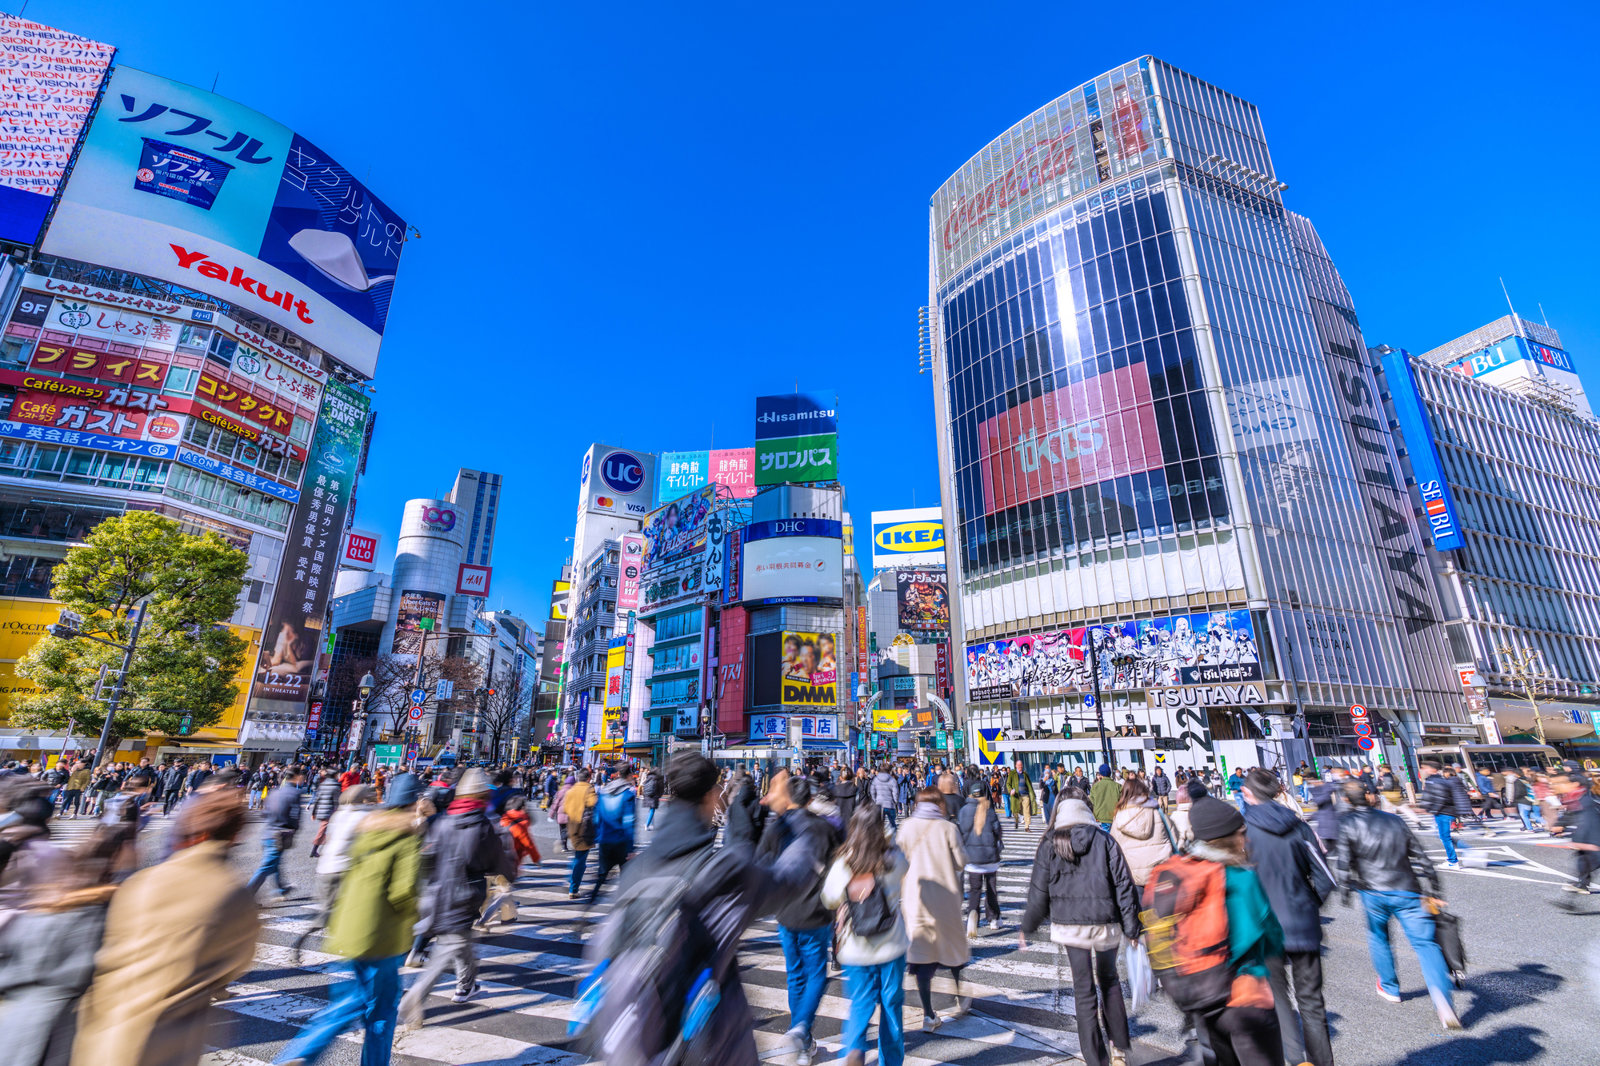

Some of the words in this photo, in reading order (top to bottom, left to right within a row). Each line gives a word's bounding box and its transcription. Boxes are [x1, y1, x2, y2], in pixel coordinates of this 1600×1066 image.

[118, 94, 273, 165] ソフール
[152, 154, 215, 183] ソフール
[290, 146, 404, 245] ヤクルトの
[1092, 180, 1145, 208] QFRONT
[282, 162, 399, 260] ヨーグルト
[45, 278, 181, 315] しゃぶしゃぶバイキング
[168, 243, 314, 325] Yakult
[20, 301, 48, 317] 9F
[96, 311, 173, 341] しゃぶ葉
[235, 323, 324, 378] しゃぶしゃぶバイキング
[37, 346, 161, 383] プライス
[264, 362, 319, 401] しゃぶ葉
[20, 400, 57, 416] Café
[105, 387, 169, 411] ガスト
[197, 375, 289, 428] コンタクト
[325, 393, 366, 422] PERFECT
[56, 405, 138, 436] ガスト
[330, 407, 356, 428] DAYS
[757, 409, 835, 424] Hisamitsu
[25, 426, 143, 453] 英会話イーオン
[150, 445, 167, 456] 6F
[257, 432, 299, 459] ガスト
[670, 461, 700, 475] 龍角散
[719, 458, 749, 473] 龍角散
[760, 447, 832, 471] サロンパス
[183, 451, 215, 470] AEON
[220, 464, 298, 499] 英会話イーオン
[666, 474, 704, 489] ダイレクト
[715, 471, 753, 486] ダイレクト
[1328, 338, 1437, 635] TSUTAYA
[627, 503, 646, 514] VISA
[1420, 480, 1454, 541] SEIBU
[775, 521, 805, 533] DHC
[882, 528, 944, 546] IKEA
[302, 479, 340, 614] 第76回カンヌ国際映画祭
[349, 547, 371, 561] QLO
[352, 537, 372, 550] UNI
[705, 512, 723, 589] もんじゃ
[465, 575, 483, 586] H&M
[1310, 636, 1352, 651] TSUTAYA
[264, 671, 302, 689] 12.22
[272, 687, 299, 695] THEATERS
[609, 675, 621, 696] 薬
[784, 685, 836, 704] DMM
[1150, 684, 1264, 709] TSUTAYA
